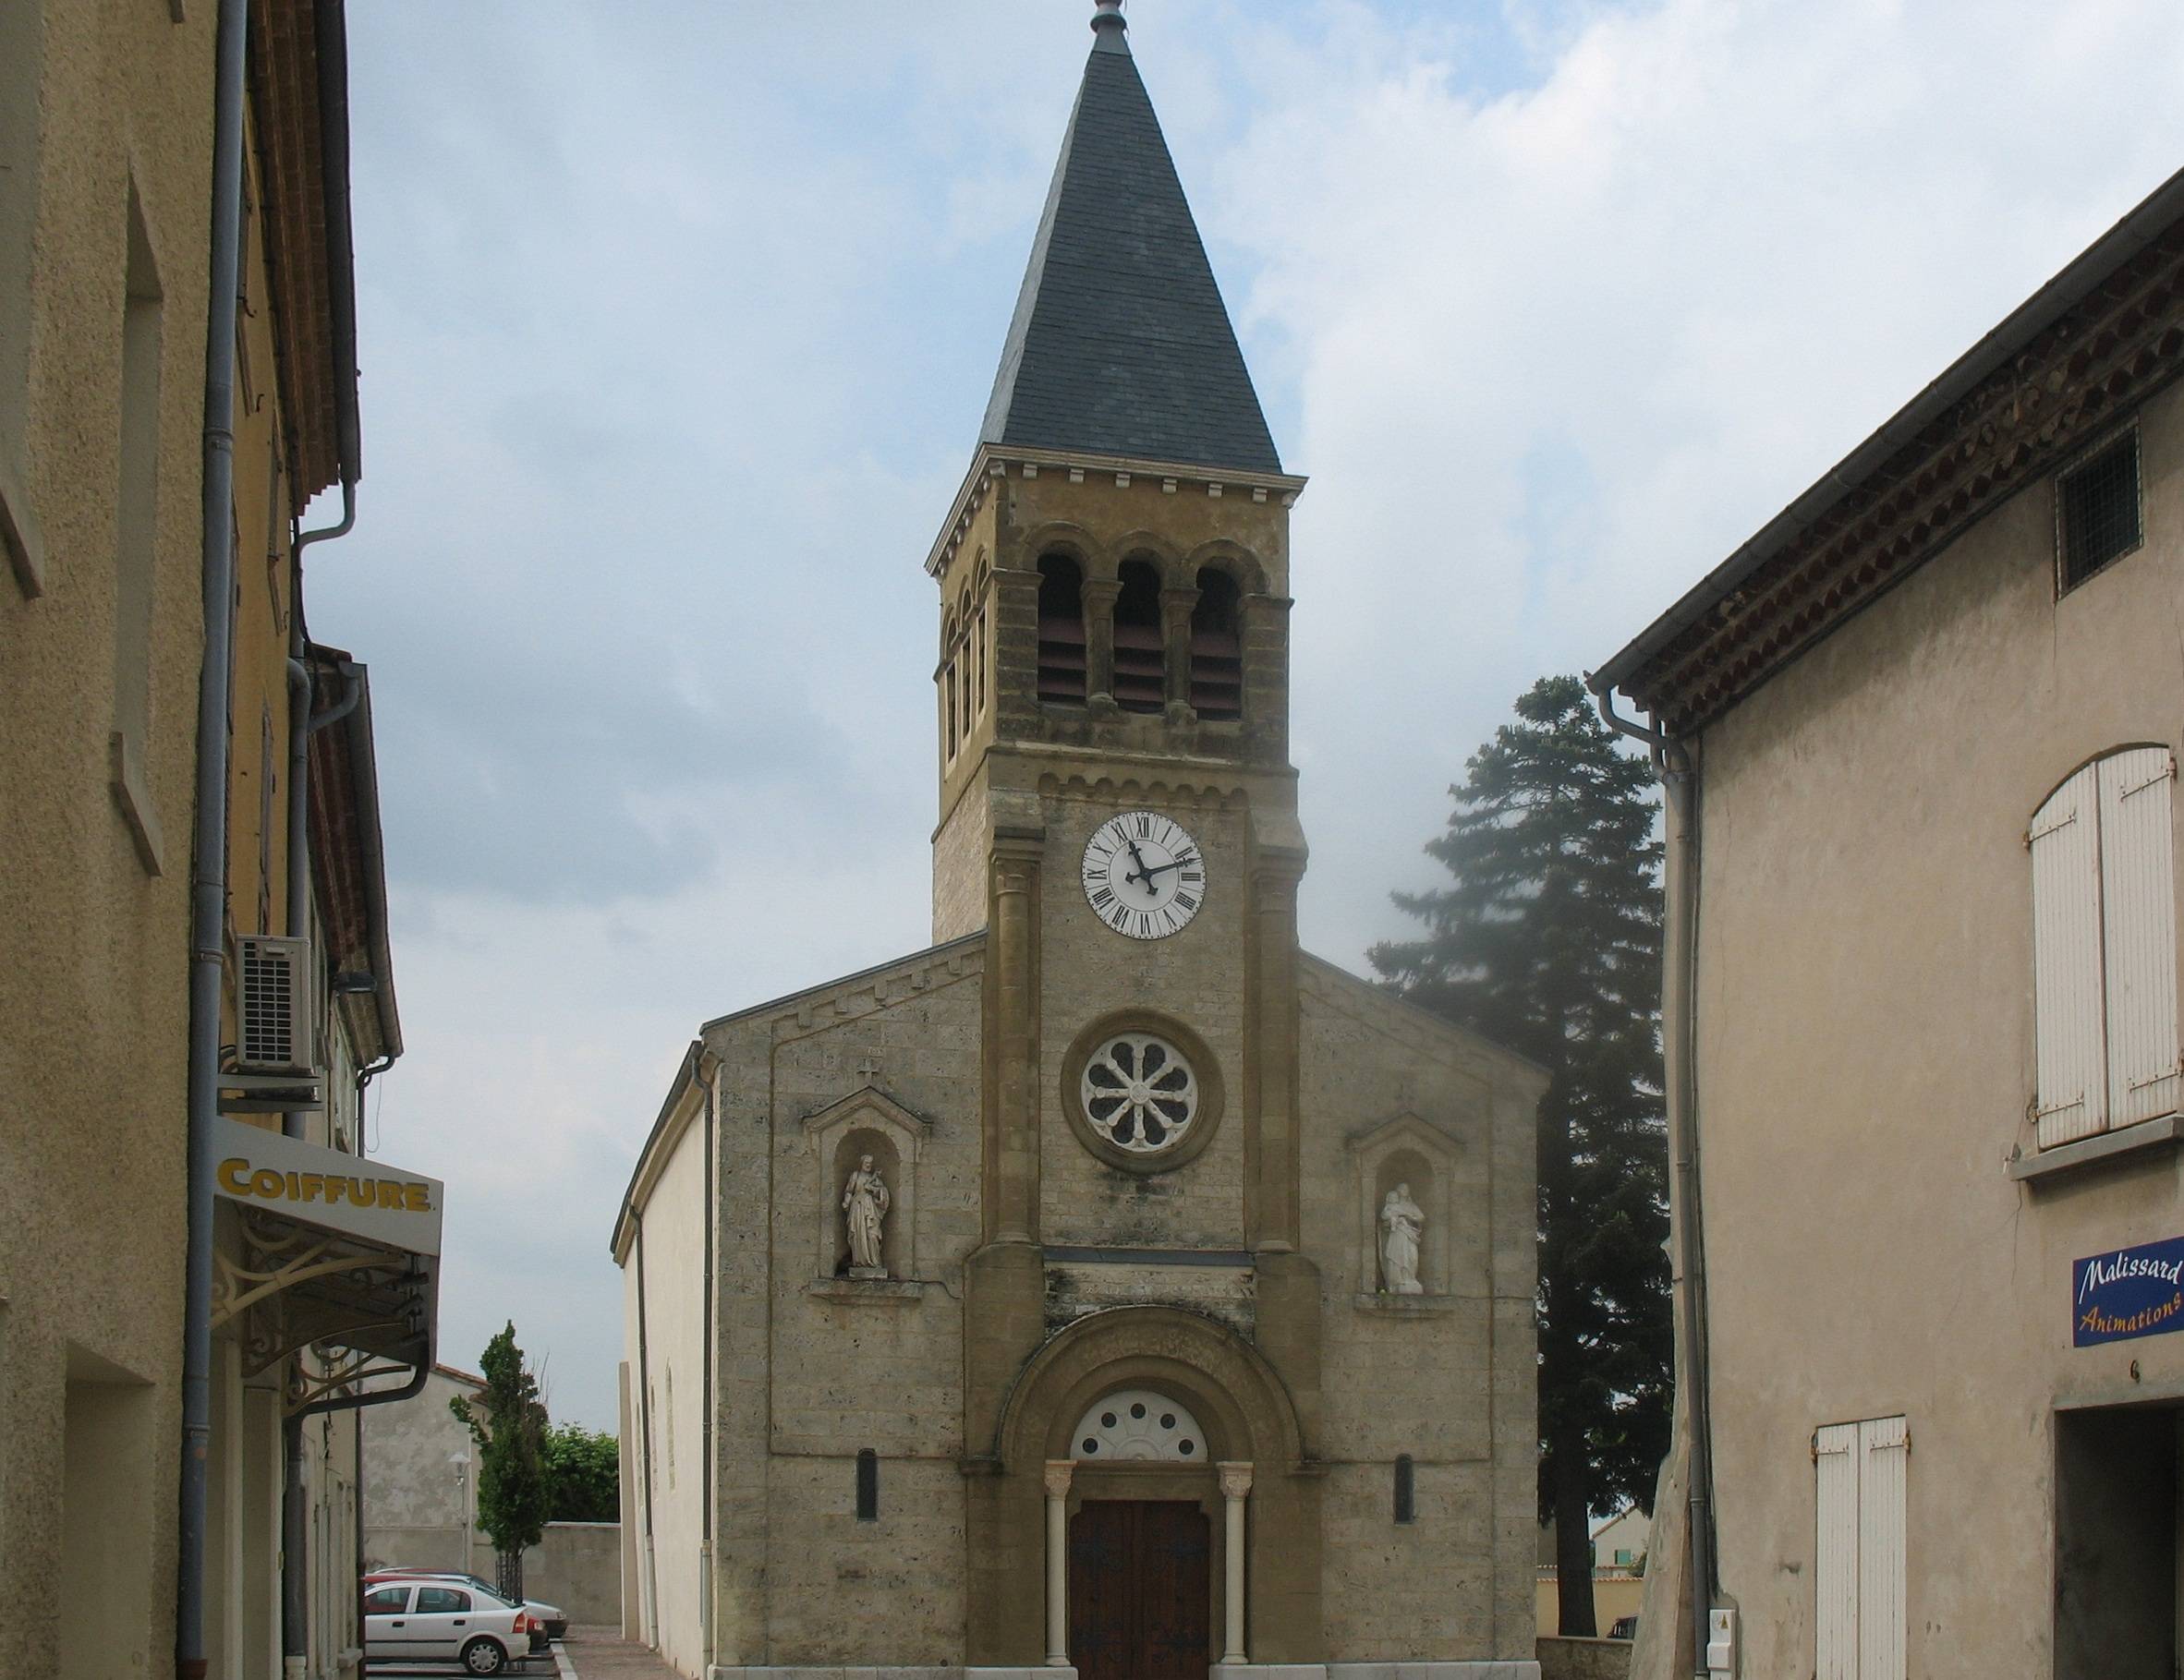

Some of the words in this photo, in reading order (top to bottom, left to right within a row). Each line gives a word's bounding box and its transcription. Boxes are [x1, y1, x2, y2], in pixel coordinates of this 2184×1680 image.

[1110, 821, 1128, 844] XI
[1135, 816, 1149, 838] XII
[1092, 842, 1112, 858] X
[1086, 868, 1108, 880] IX
[1181, 872, 1201, 882] III
[1092, 888, 1115, 910] VIII
[1111, 905, 1130, 928] VII
[1163, 909, 1177, 928] V
[2078, 1251, 2184, 1305] Malissard
[2079, 1292, 2181, 1333] Animations
[2129, 1360, 2141, 1384] 6
